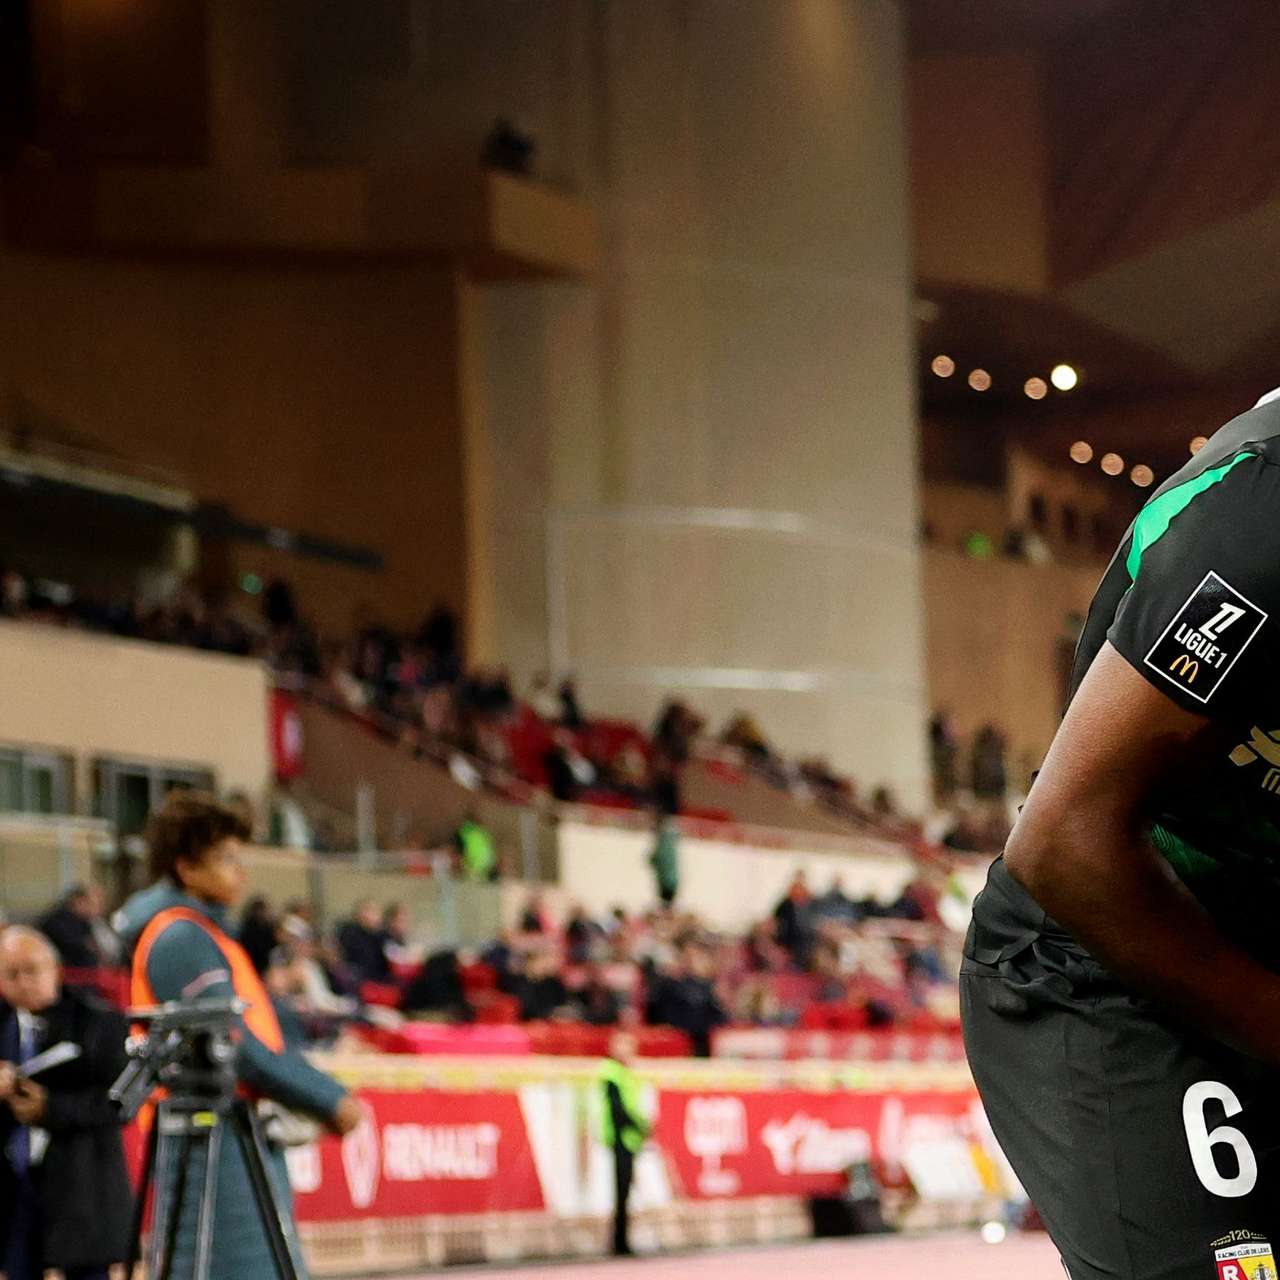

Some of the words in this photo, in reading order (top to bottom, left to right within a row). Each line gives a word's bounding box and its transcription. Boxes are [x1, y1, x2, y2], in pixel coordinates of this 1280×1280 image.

[1173, 621, 1221, 665] LIGUE
[1213, 651, 1228, 669] 1
[1182, 1080, 1258, 1198] 6
[1229, 1229, 1251, 1241] 120
